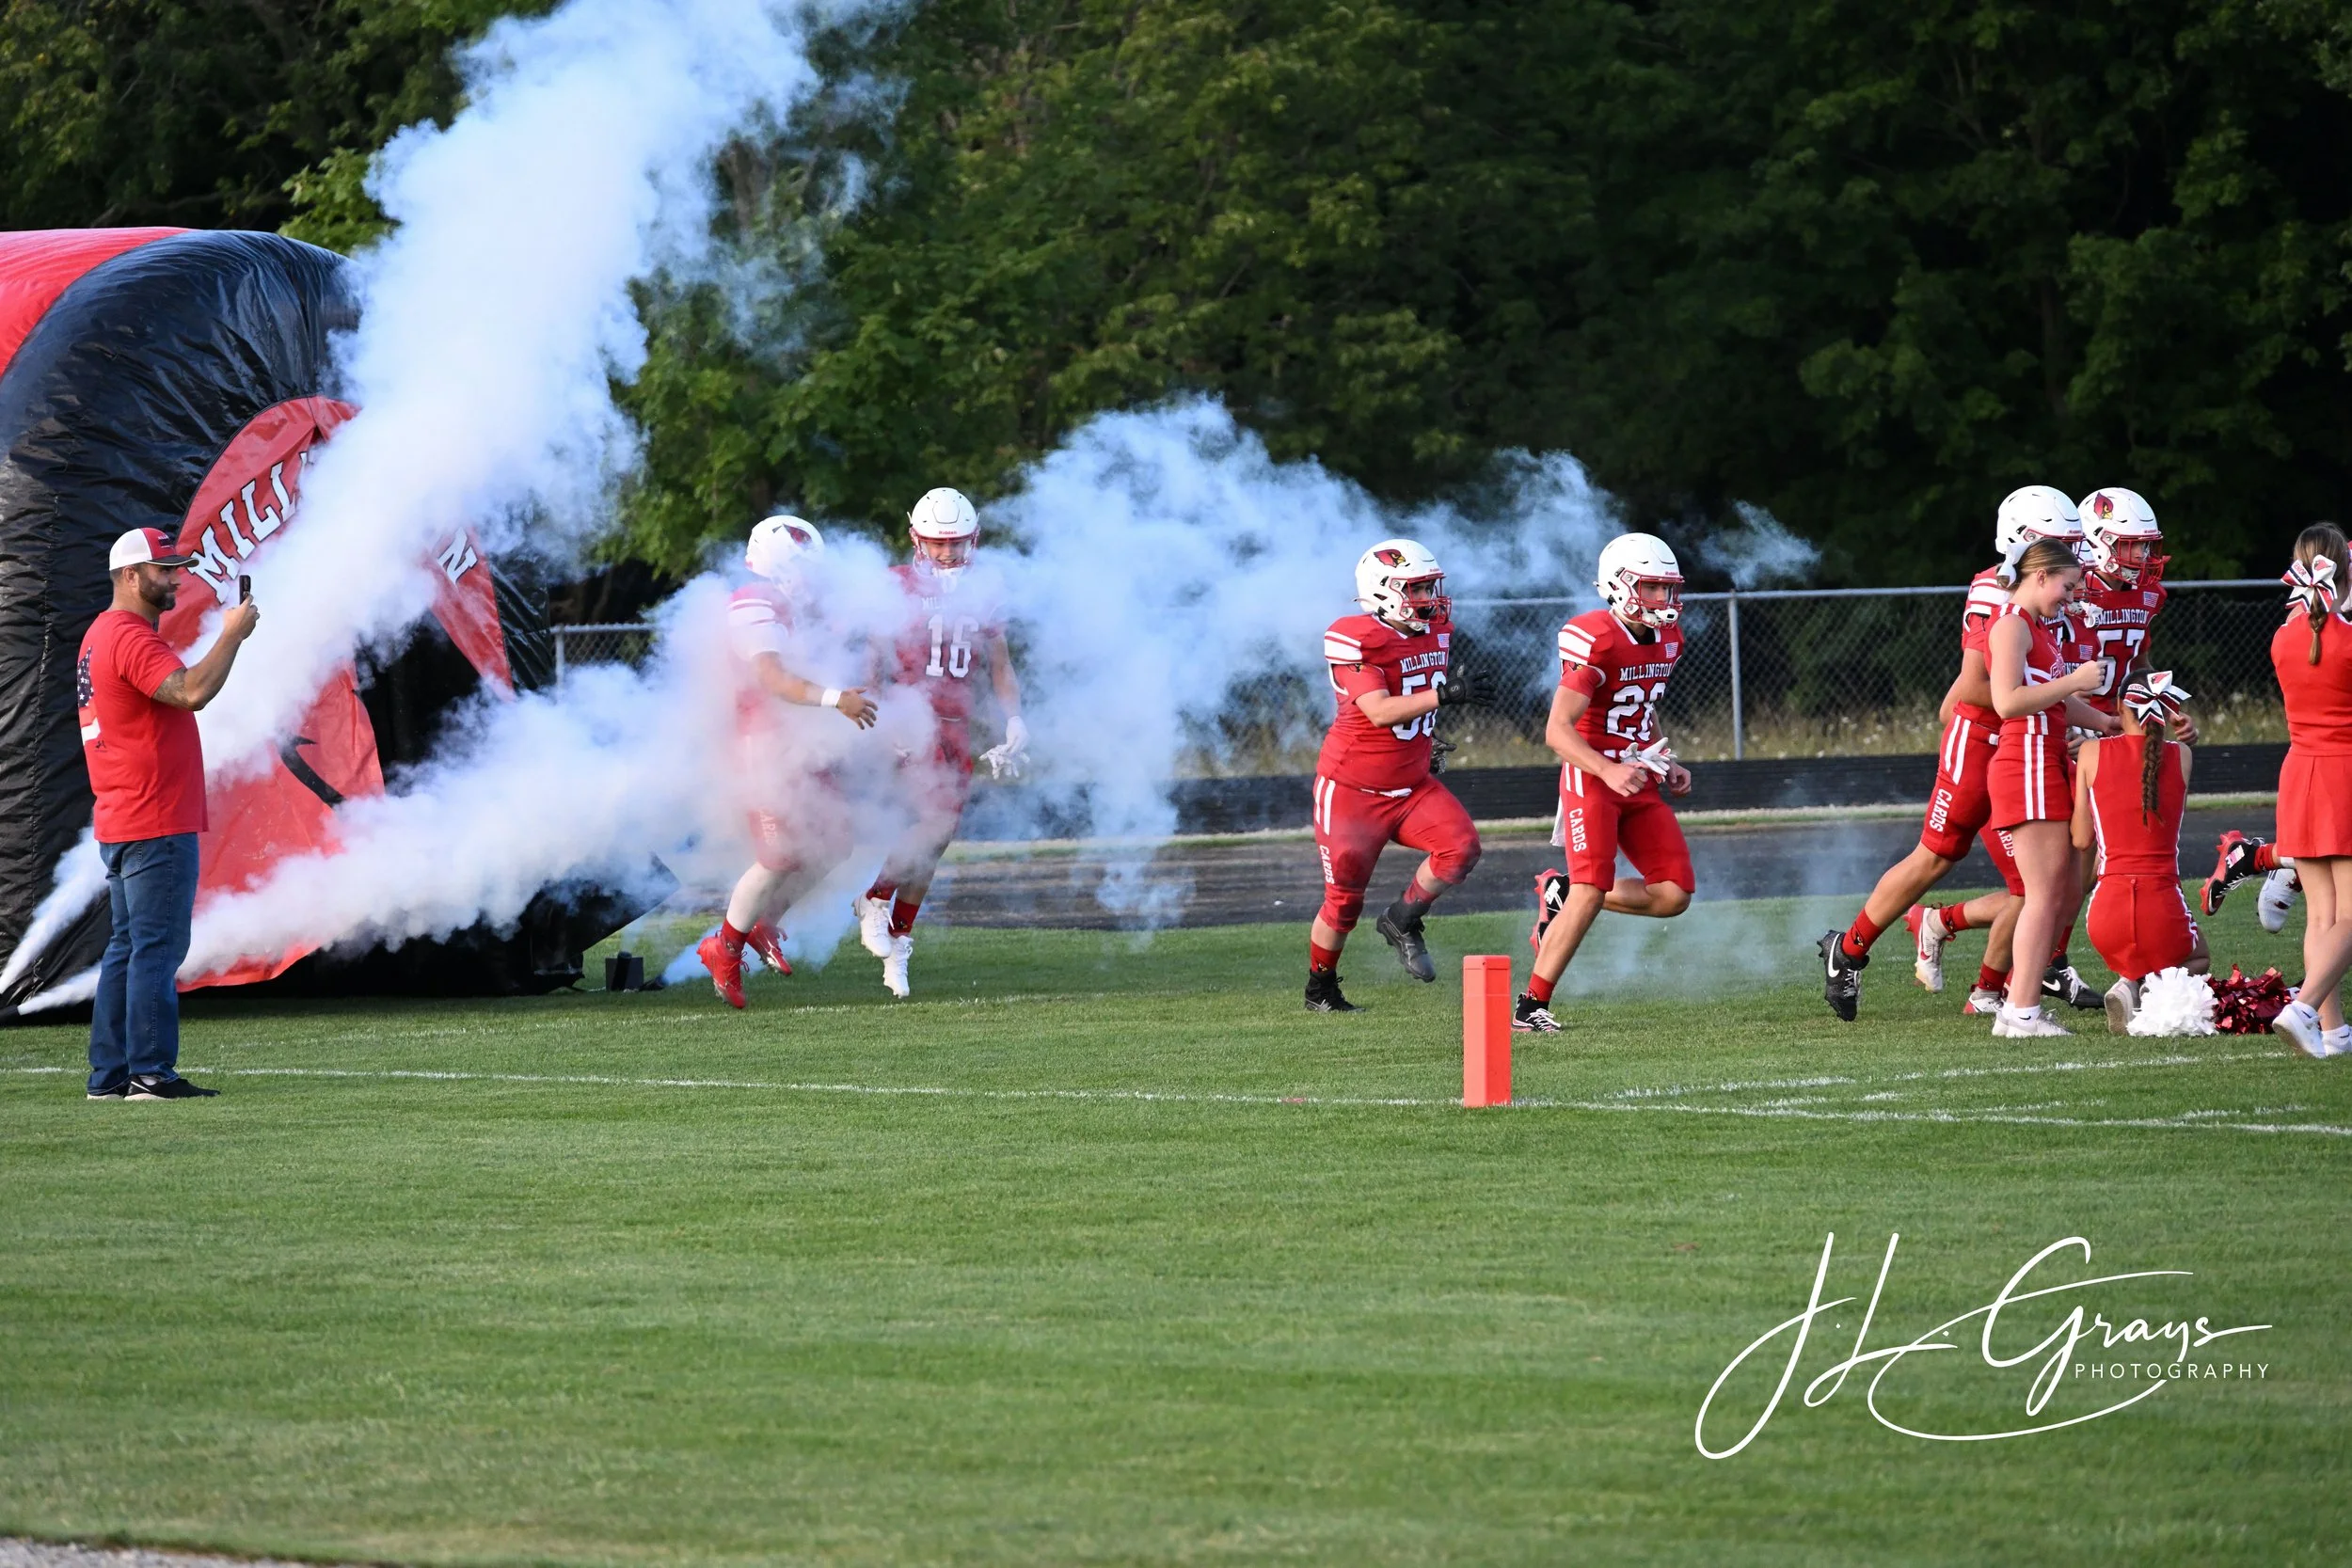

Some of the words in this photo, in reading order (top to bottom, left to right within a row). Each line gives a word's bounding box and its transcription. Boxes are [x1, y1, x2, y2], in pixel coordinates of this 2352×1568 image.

[926, 614, 978, 677] 16
[1400, 651, 1445, 673] MILLINGTON
[2089, 629, 2145, 695] 57
[1569, 808, 1587, 852] CARDS
[1929, 788, 1952, 832] CARDS
[1319, 845, 1334, 884] CARDS
[1997, 831, 2014, 857] ARDS
